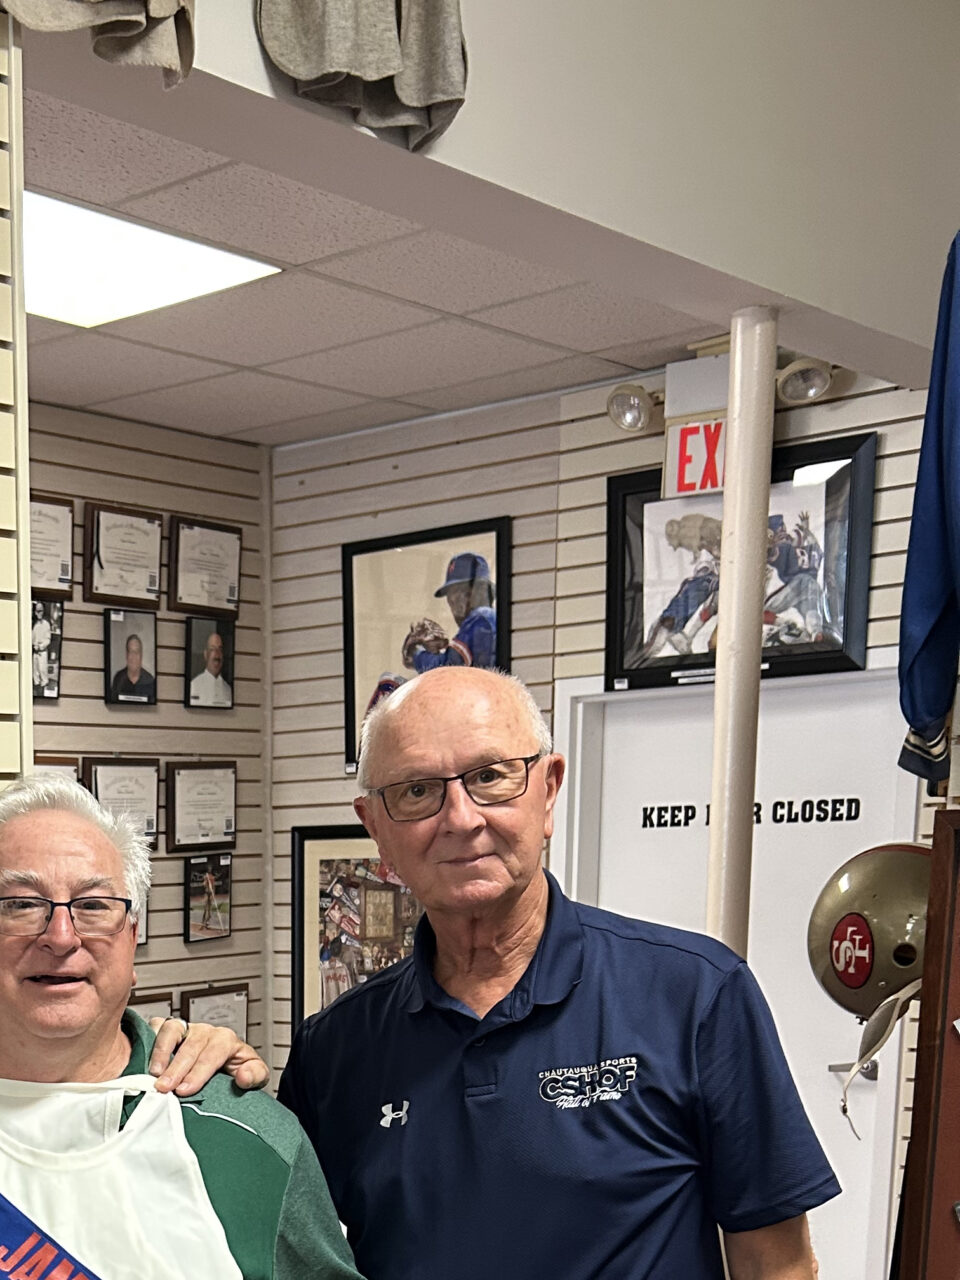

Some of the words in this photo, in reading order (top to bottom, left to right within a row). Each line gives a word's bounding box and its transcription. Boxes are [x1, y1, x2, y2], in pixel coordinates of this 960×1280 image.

[677, 422, 724, 493] EX
[642, 805, 696, 828] KEEP
[772, 798, 861, 824] CLOSED
[538, 1063, 599, 1079] CHAUTAUQUA
[600, 1056, 637, 1068] SPORTS
[540, 1064, 638, 1102] CSHOF
[556, 1096, 580, 1110] Hall
[592, 1092, 622, 1103] Fame
